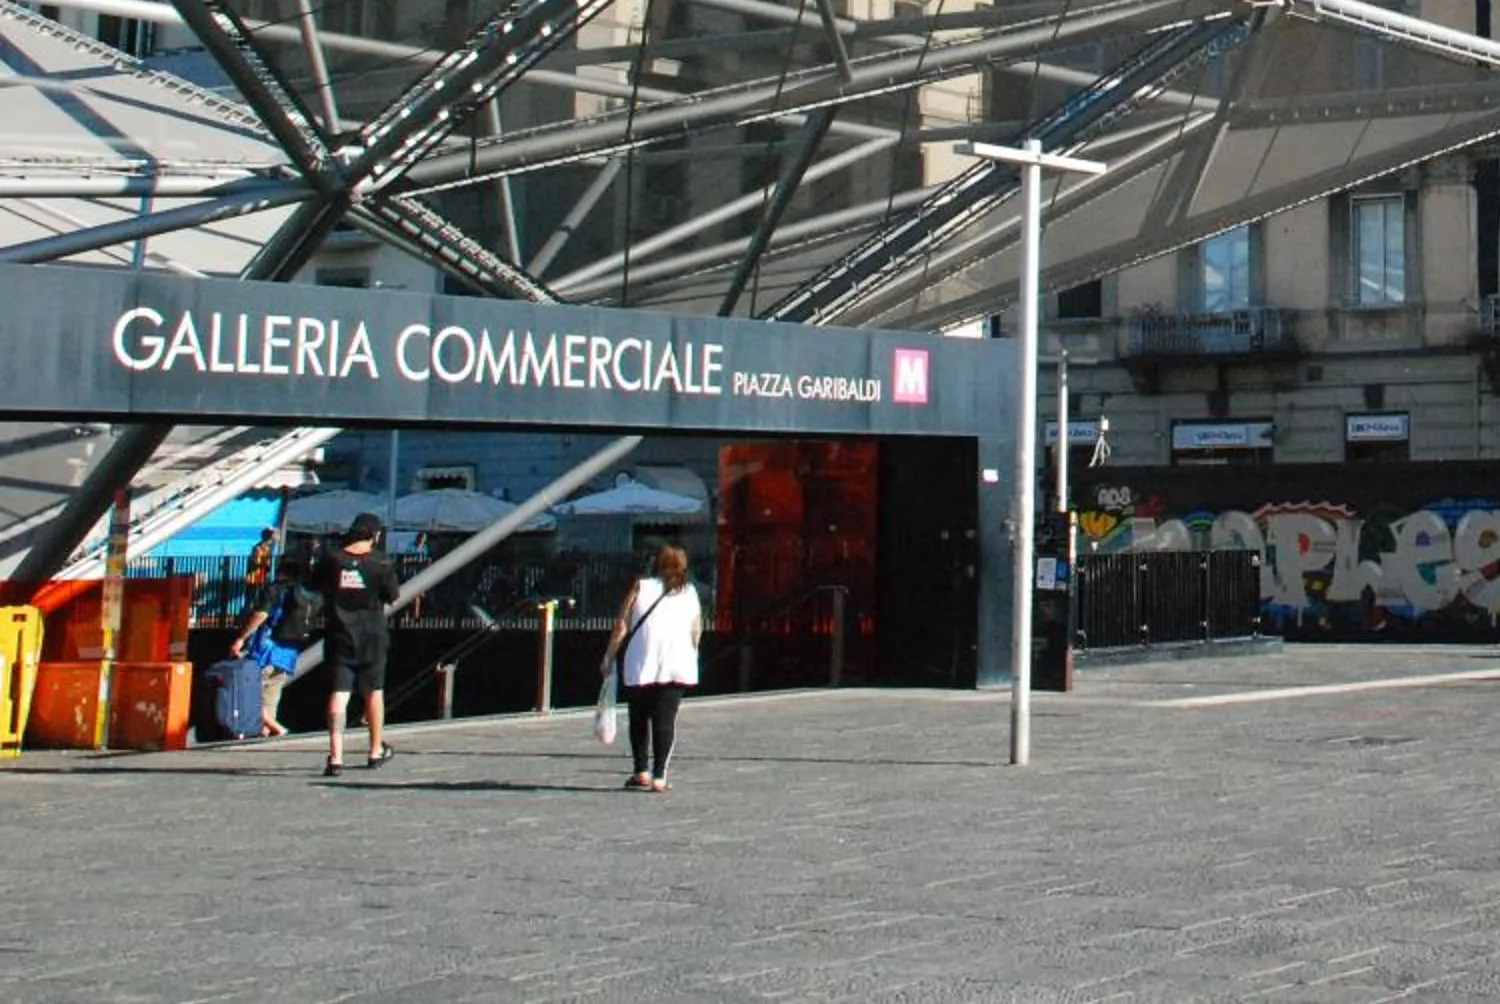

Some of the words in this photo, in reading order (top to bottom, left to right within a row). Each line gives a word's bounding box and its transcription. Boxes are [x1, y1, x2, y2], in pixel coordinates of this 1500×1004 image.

[112, 306, 380, 380] GALLERIA
[396, 323, 724, 395] COMMERCIALE
[732, 371, 794, 398] PIAZZA
[797, 374, 882, 403] GARIBALDI
[899, 355, 926, 396] M
